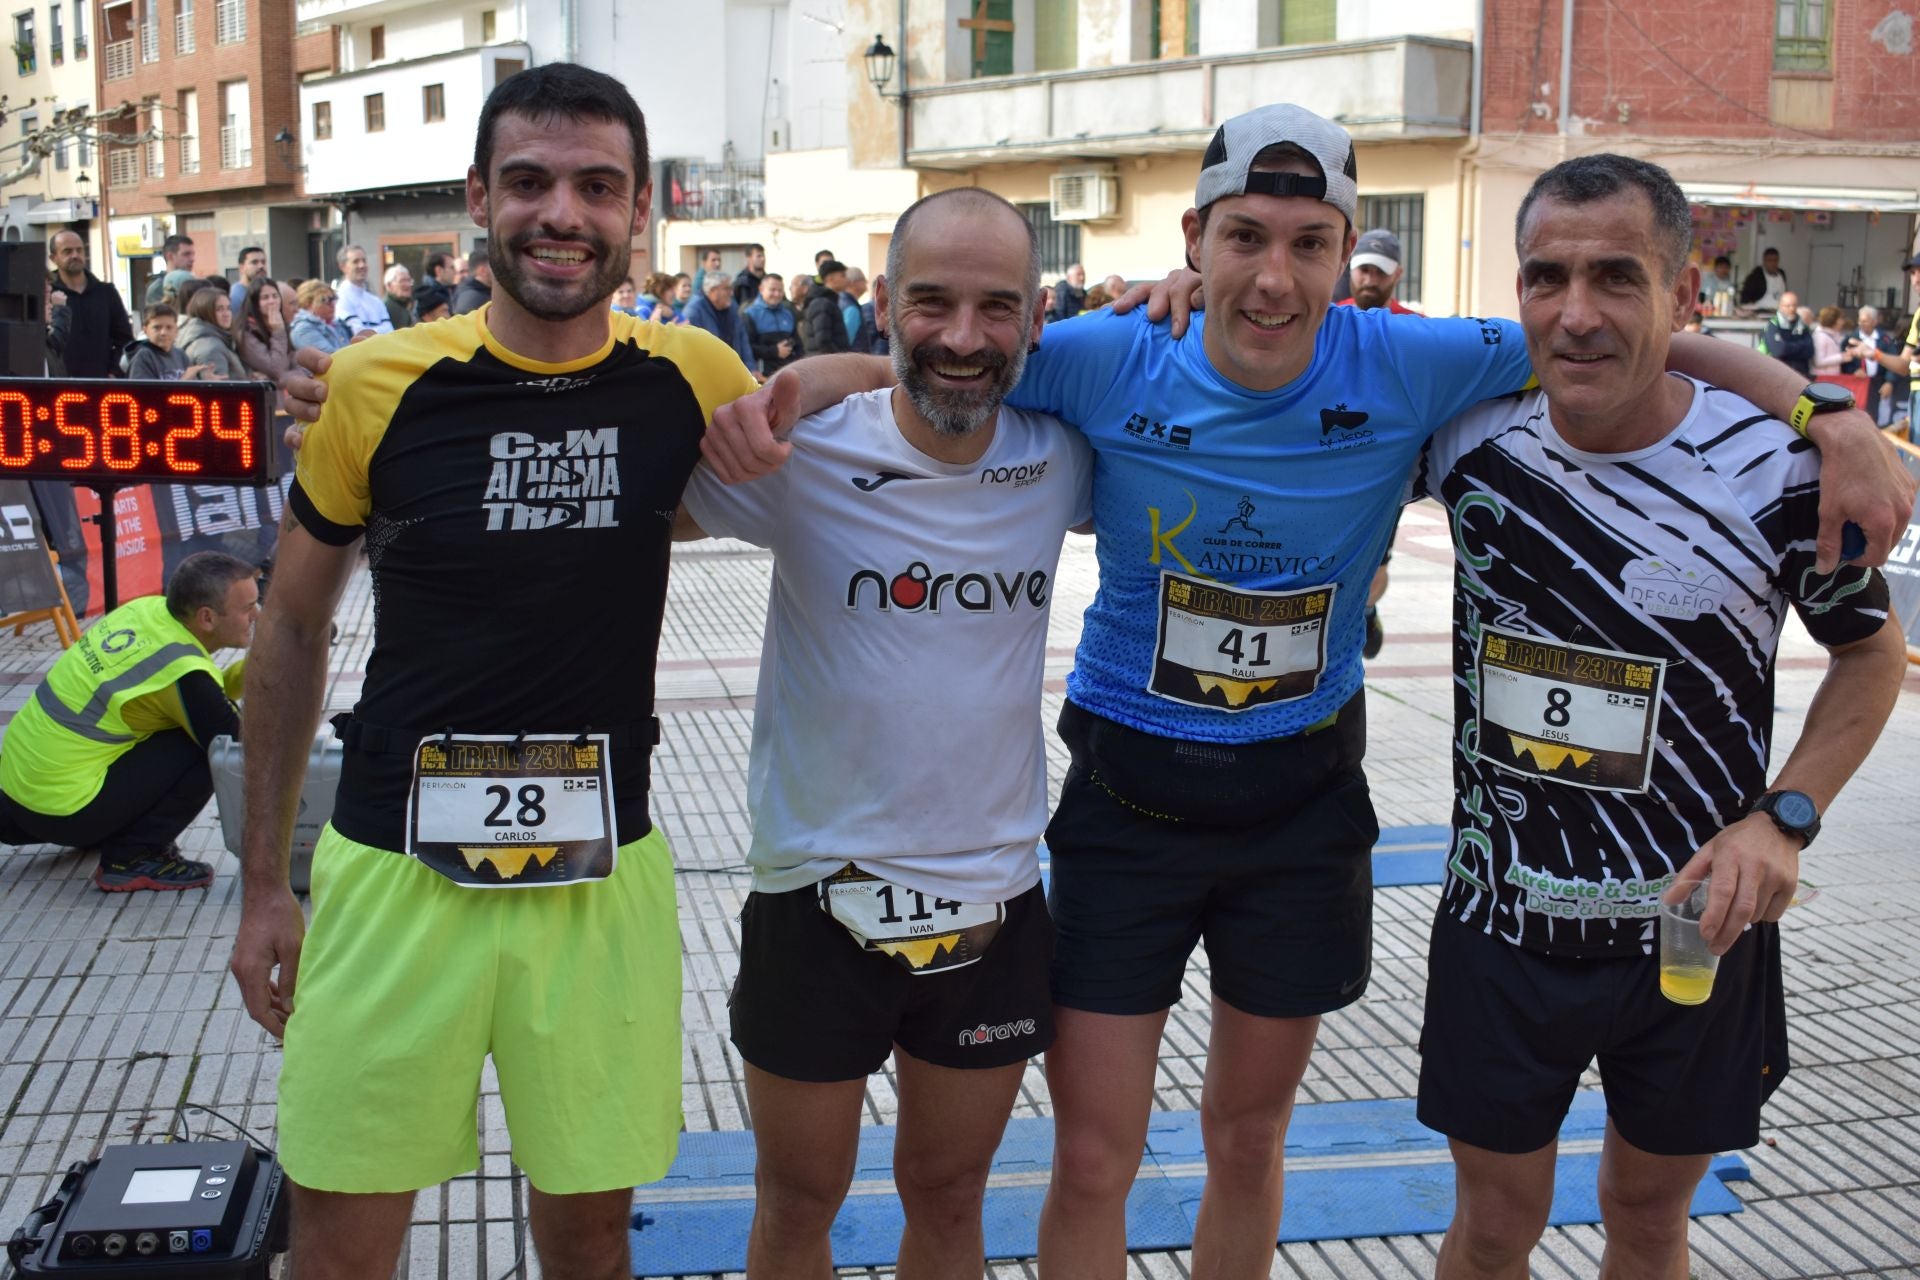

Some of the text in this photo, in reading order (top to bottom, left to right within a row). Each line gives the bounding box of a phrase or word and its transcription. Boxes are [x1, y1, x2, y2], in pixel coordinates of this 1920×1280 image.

[490, 427, 618, 459] CxM
[980, 461, 1047, 484] norave
[124, 517, 143, 534] THE
[1203, 537, 1282, 550] CLUB DE CORRER
[848, 562, 1047, 611] norave
[1192, 586, 1254, 619] TRAIL
[1260, 597, 1306, 621] 23K
[1218, 628, 1271, 666] 41
[1231, 668, 1257, 678] RAUL
[1507, 641, 1568, 675] TRAIL
[1573, 654, 1624, 685] 23K
[1543, 687, 1572, 727] 8
[1541, 729, 1569, 741] JESUS
[451, 744, 574, 770] TRAIL 23K
[484, 784, 546, 827] 28
[495, 831, 537, 841] CARLOS
[1508, 864, 1598, 898] Atrévete
[1604, 882, 1620, 898] &
[1529, 894, 1573, 915] Dare
[1580, 903, 1593, 915] &
[909, 924, 934, 934] IVAN
[959, 1018, 1036, 1045] norave
